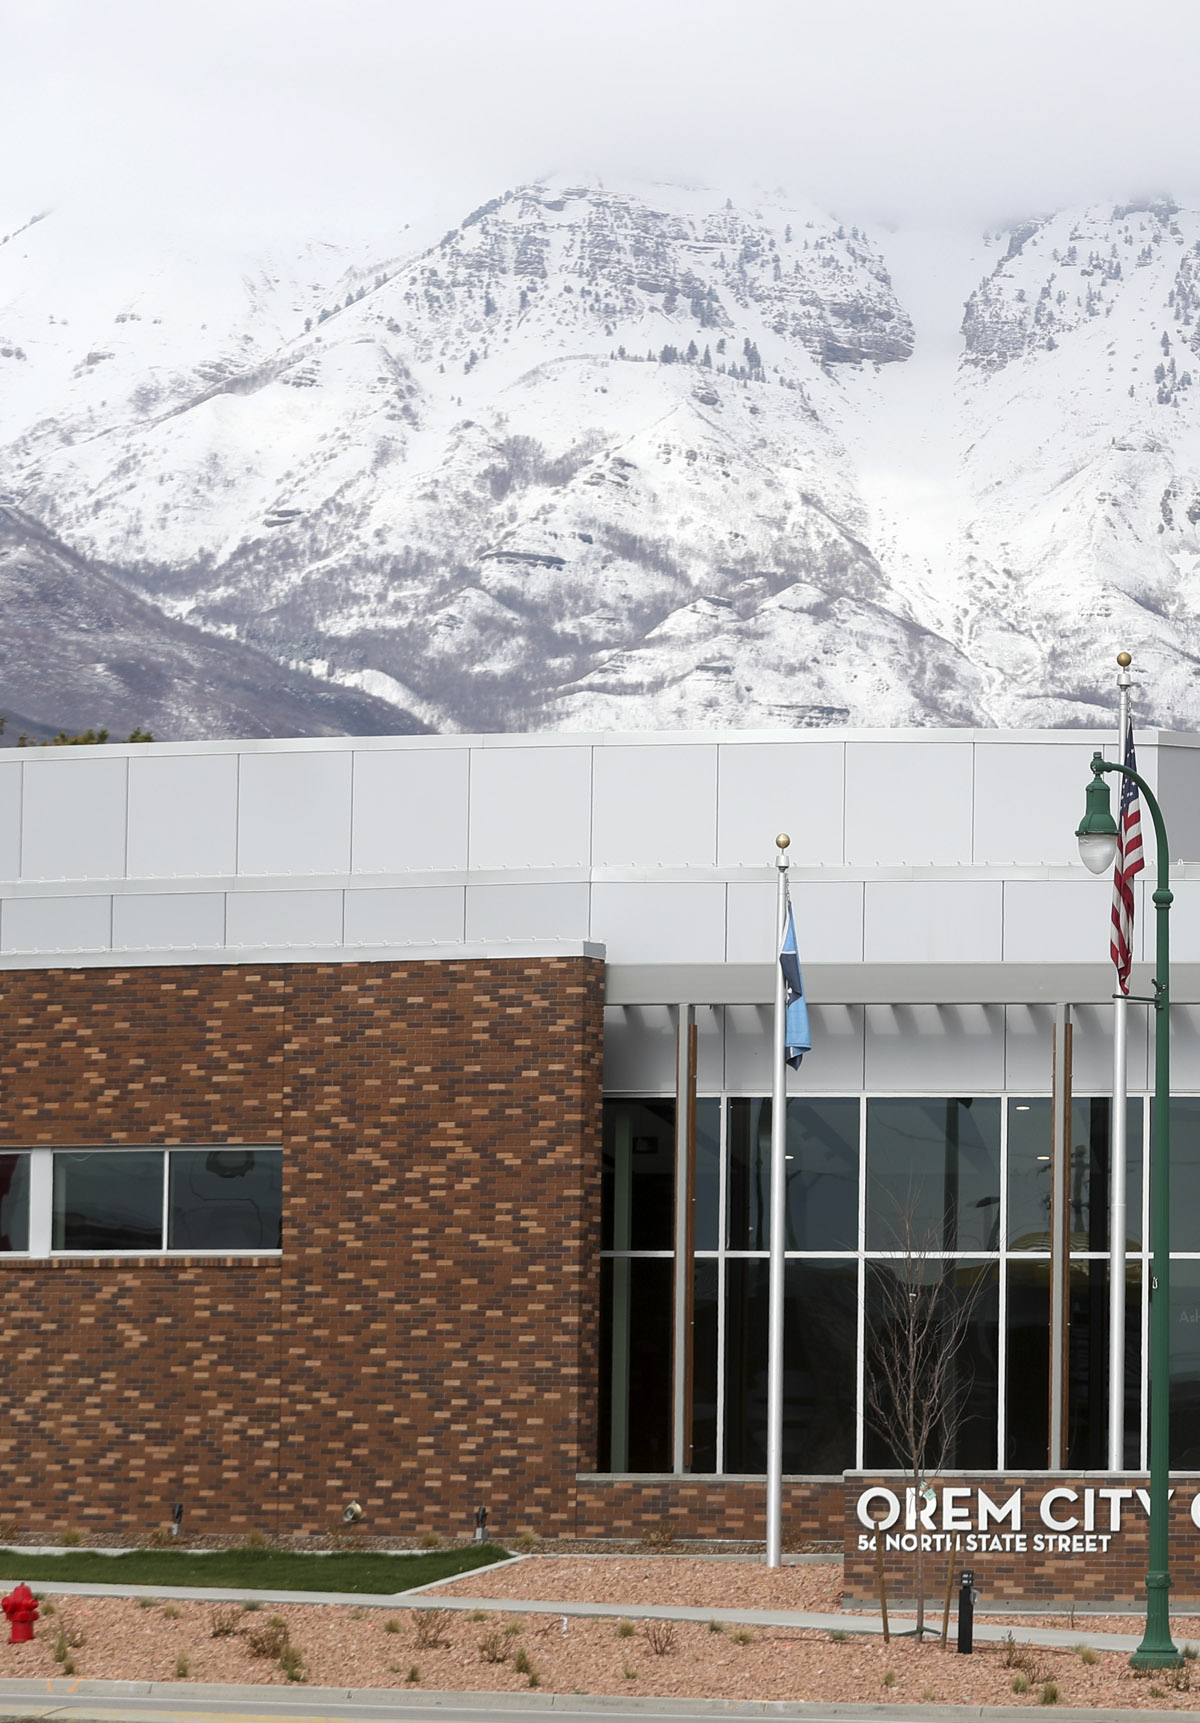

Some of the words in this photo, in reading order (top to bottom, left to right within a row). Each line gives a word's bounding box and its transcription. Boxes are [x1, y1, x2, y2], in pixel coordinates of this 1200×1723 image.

[856, 1486, 1022, 1531] OREM
[885, 1533, 961, 1552] NORTH
[966, 1533, 1028, 1552] STATE
[1033, 1533, 1112, 1553] STREET
